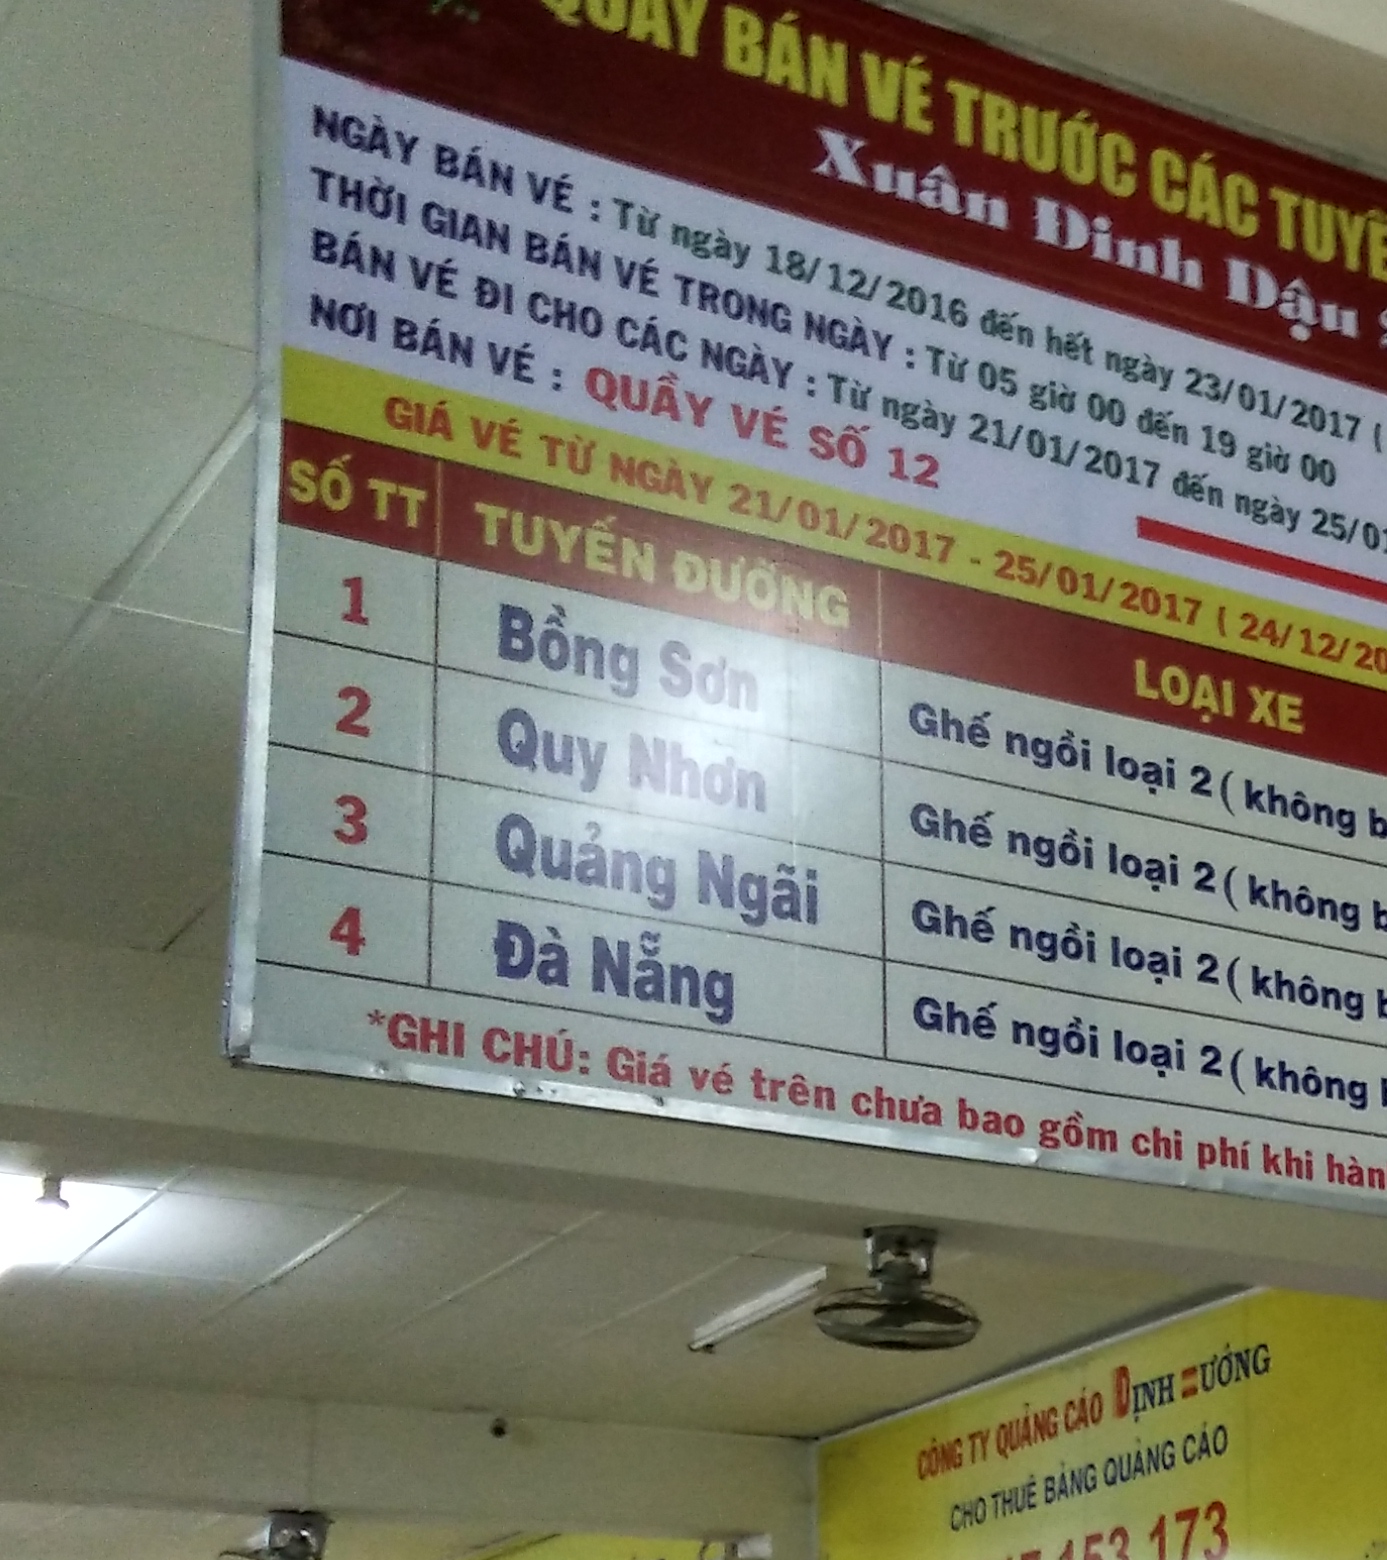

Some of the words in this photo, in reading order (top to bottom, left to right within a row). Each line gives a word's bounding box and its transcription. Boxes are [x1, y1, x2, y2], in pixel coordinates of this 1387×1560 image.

[723, 5, 848, 107] BÁN
[861, 51, 934, 135] VÉ
[946, 79, 1136, 197] TRƯỚC
[1149, 147, 1260, 238] CÁC
[811, 126, 1010, 231] Xuân
[1033, 196, 1202, 291] Đinh
[1227, 259, 1360, 342] Dậu
[287, 455, 353, 513] SỐ
[369, 480, 427, 528] TT
[475, 501, 657, 584] TUYẾN
[341, 576, 371, 627] 1
[498, 601, 640, 700] Bồng
[657, 639, 760, 715] Sơn
[1133, 656, 1235, 727] LOẠI
[1251, 687, 1305, 735] XE
[335, 685, 371, 738] 2
[496, 708, 608, 793] Quy
[629, 731, 769, 813] Nhơn
[333, 793, 369, 846] 3
[495, 812, 678, 912] Quảng
[697, 850, 820, 928] Ngãi
[329, 905, 366, 956] 4
[493, 920, 571, 989] Đà
[950, 1499, 988, 1532] CHO
[1181, 1422, 1229, 1467] CÁO
